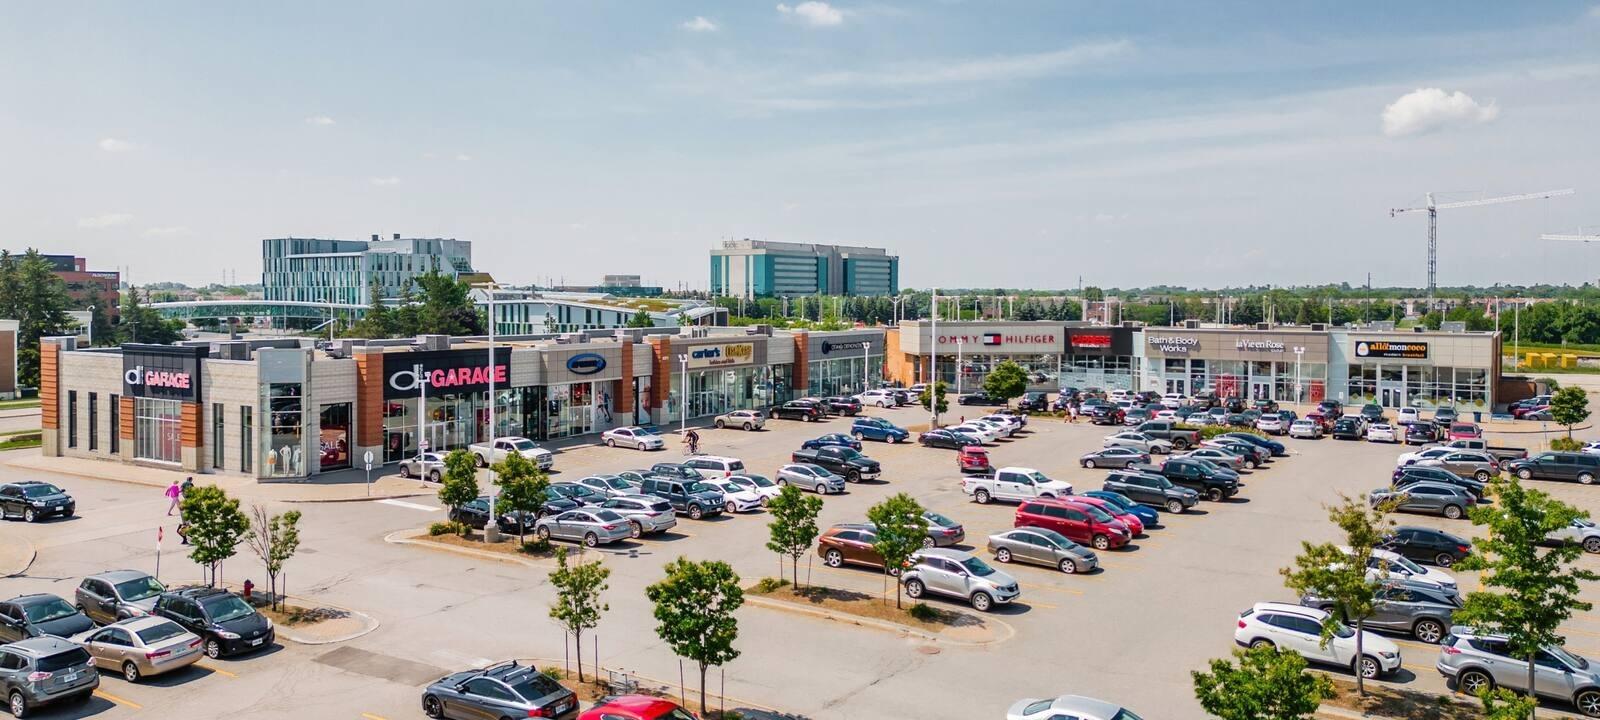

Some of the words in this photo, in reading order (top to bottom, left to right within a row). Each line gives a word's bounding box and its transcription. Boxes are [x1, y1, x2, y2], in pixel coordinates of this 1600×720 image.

[1006, 335, 1055, 344] HILFIGER
[1149, 336, 1168, 344] Bath
[1176, 337, 1198, 346] Body
[1160, 344, 1187, 353] Works
[1266, 340, 1284, 349] Rose
[692, 347, 721, 359] carter's
[146, 370, 190, 389] GARAGE
